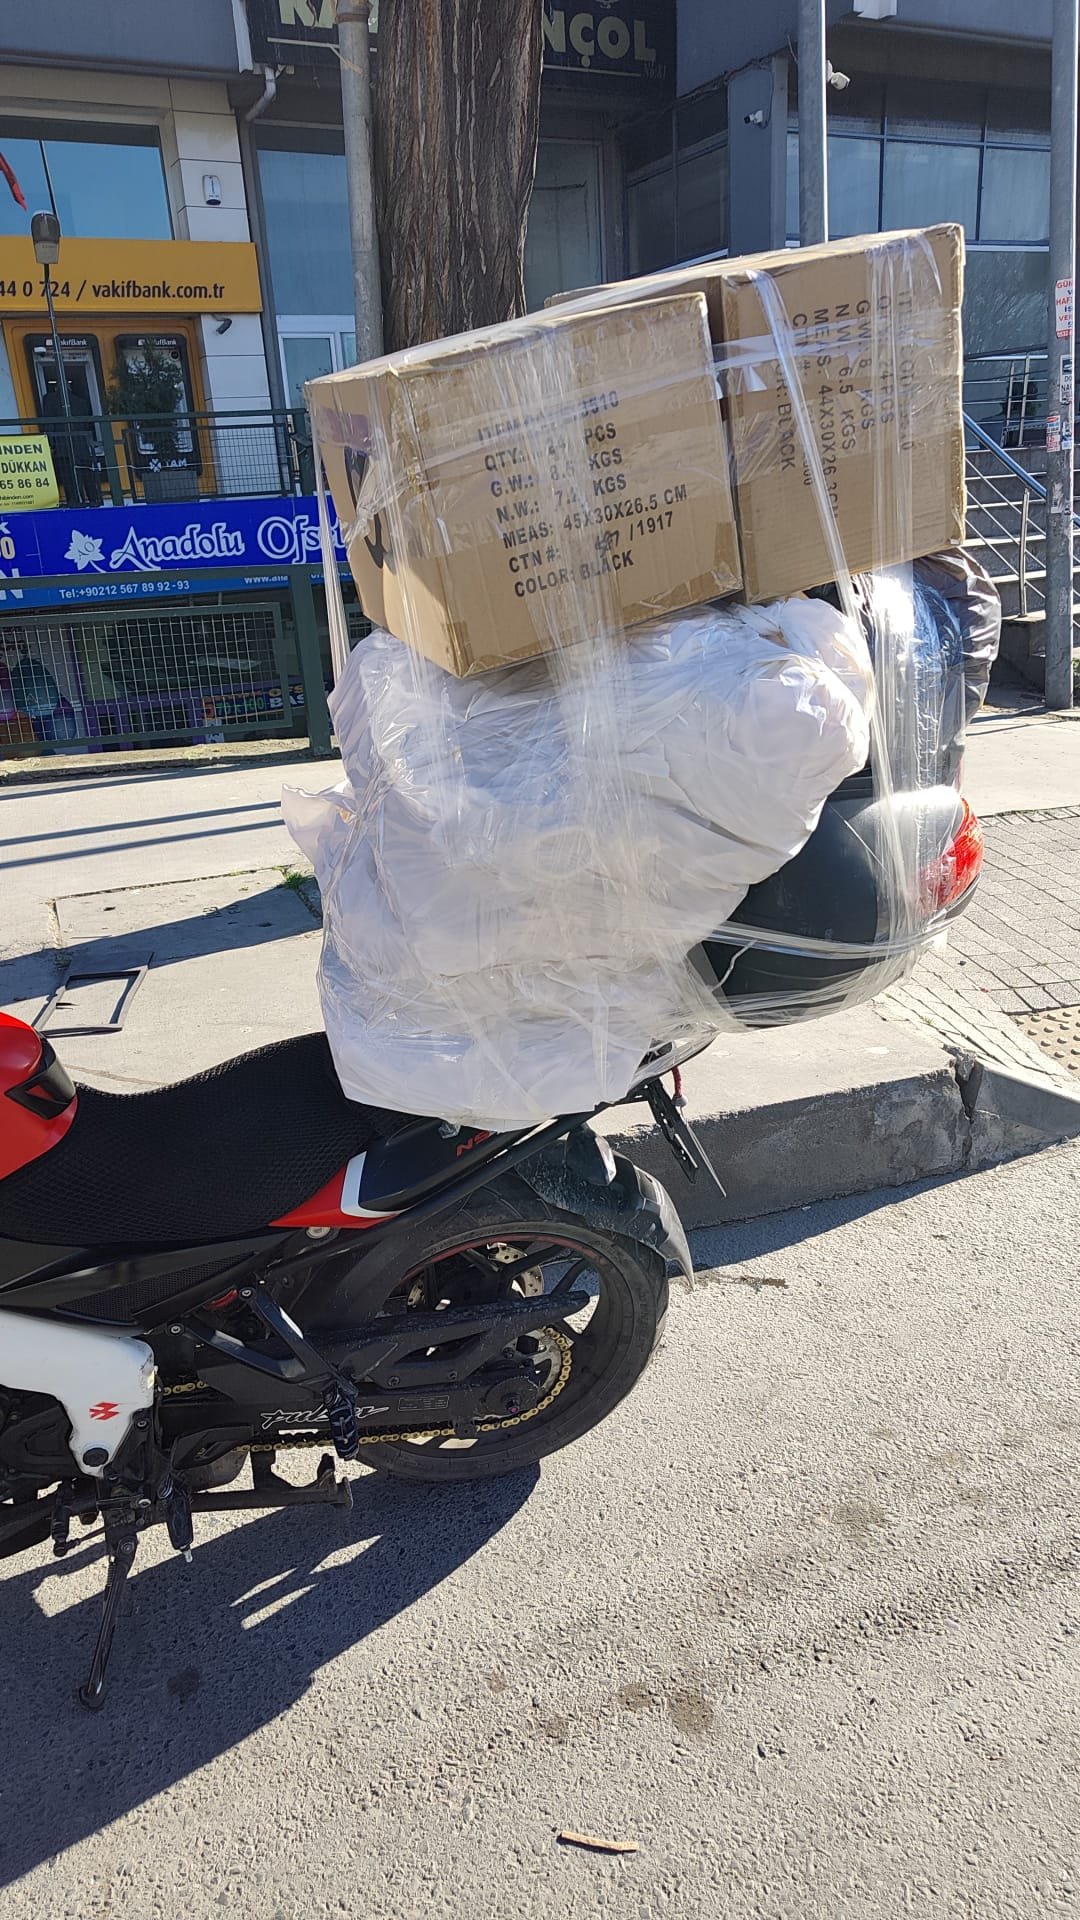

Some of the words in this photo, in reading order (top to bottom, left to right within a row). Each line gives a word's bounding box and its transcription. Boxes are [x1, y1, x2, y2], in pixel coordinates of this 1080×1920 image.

[23, 281, 33, 297] 0
[40, 281, 71, 297] 724
[76, 280, 86, 301] /
[92, 281, 225, 298] vakifbank.com.tr
[838, 366, 854, 394] 6.5
[584, 422, 617, 445] PCS
[777, 402, 796, 472] BLACK
[841, 409, 857, 450] KGS
[1, 460, 47, 474] DÜKKAN
[588, 447, 623, 471] KGS
[0, 480, 14, 489] 65
[18, 479, 32, 488] 86
[35, 478, 49, 488] 84
[496, 501, 540, 524] N.W.:
[593, 473, 627, 497] KGS
[502, 521, 554, 549] MEAS:
[563, 494, 658, 531] 45X30X26.5
[664, 484, 688, 505] CM
[109, 522, 246, 571] Anadolu
[257, 515, 346, 564] Ofst
[509, 550, 542, 573] CTN
[515, 567, 576, 598] COLOR:
[581, 550, 634, 581] BLACK
[59, 585, 118, 600] Tel:+90212
[121, 583, 138, 594] 567
[142, 582, 155, 592] 89
